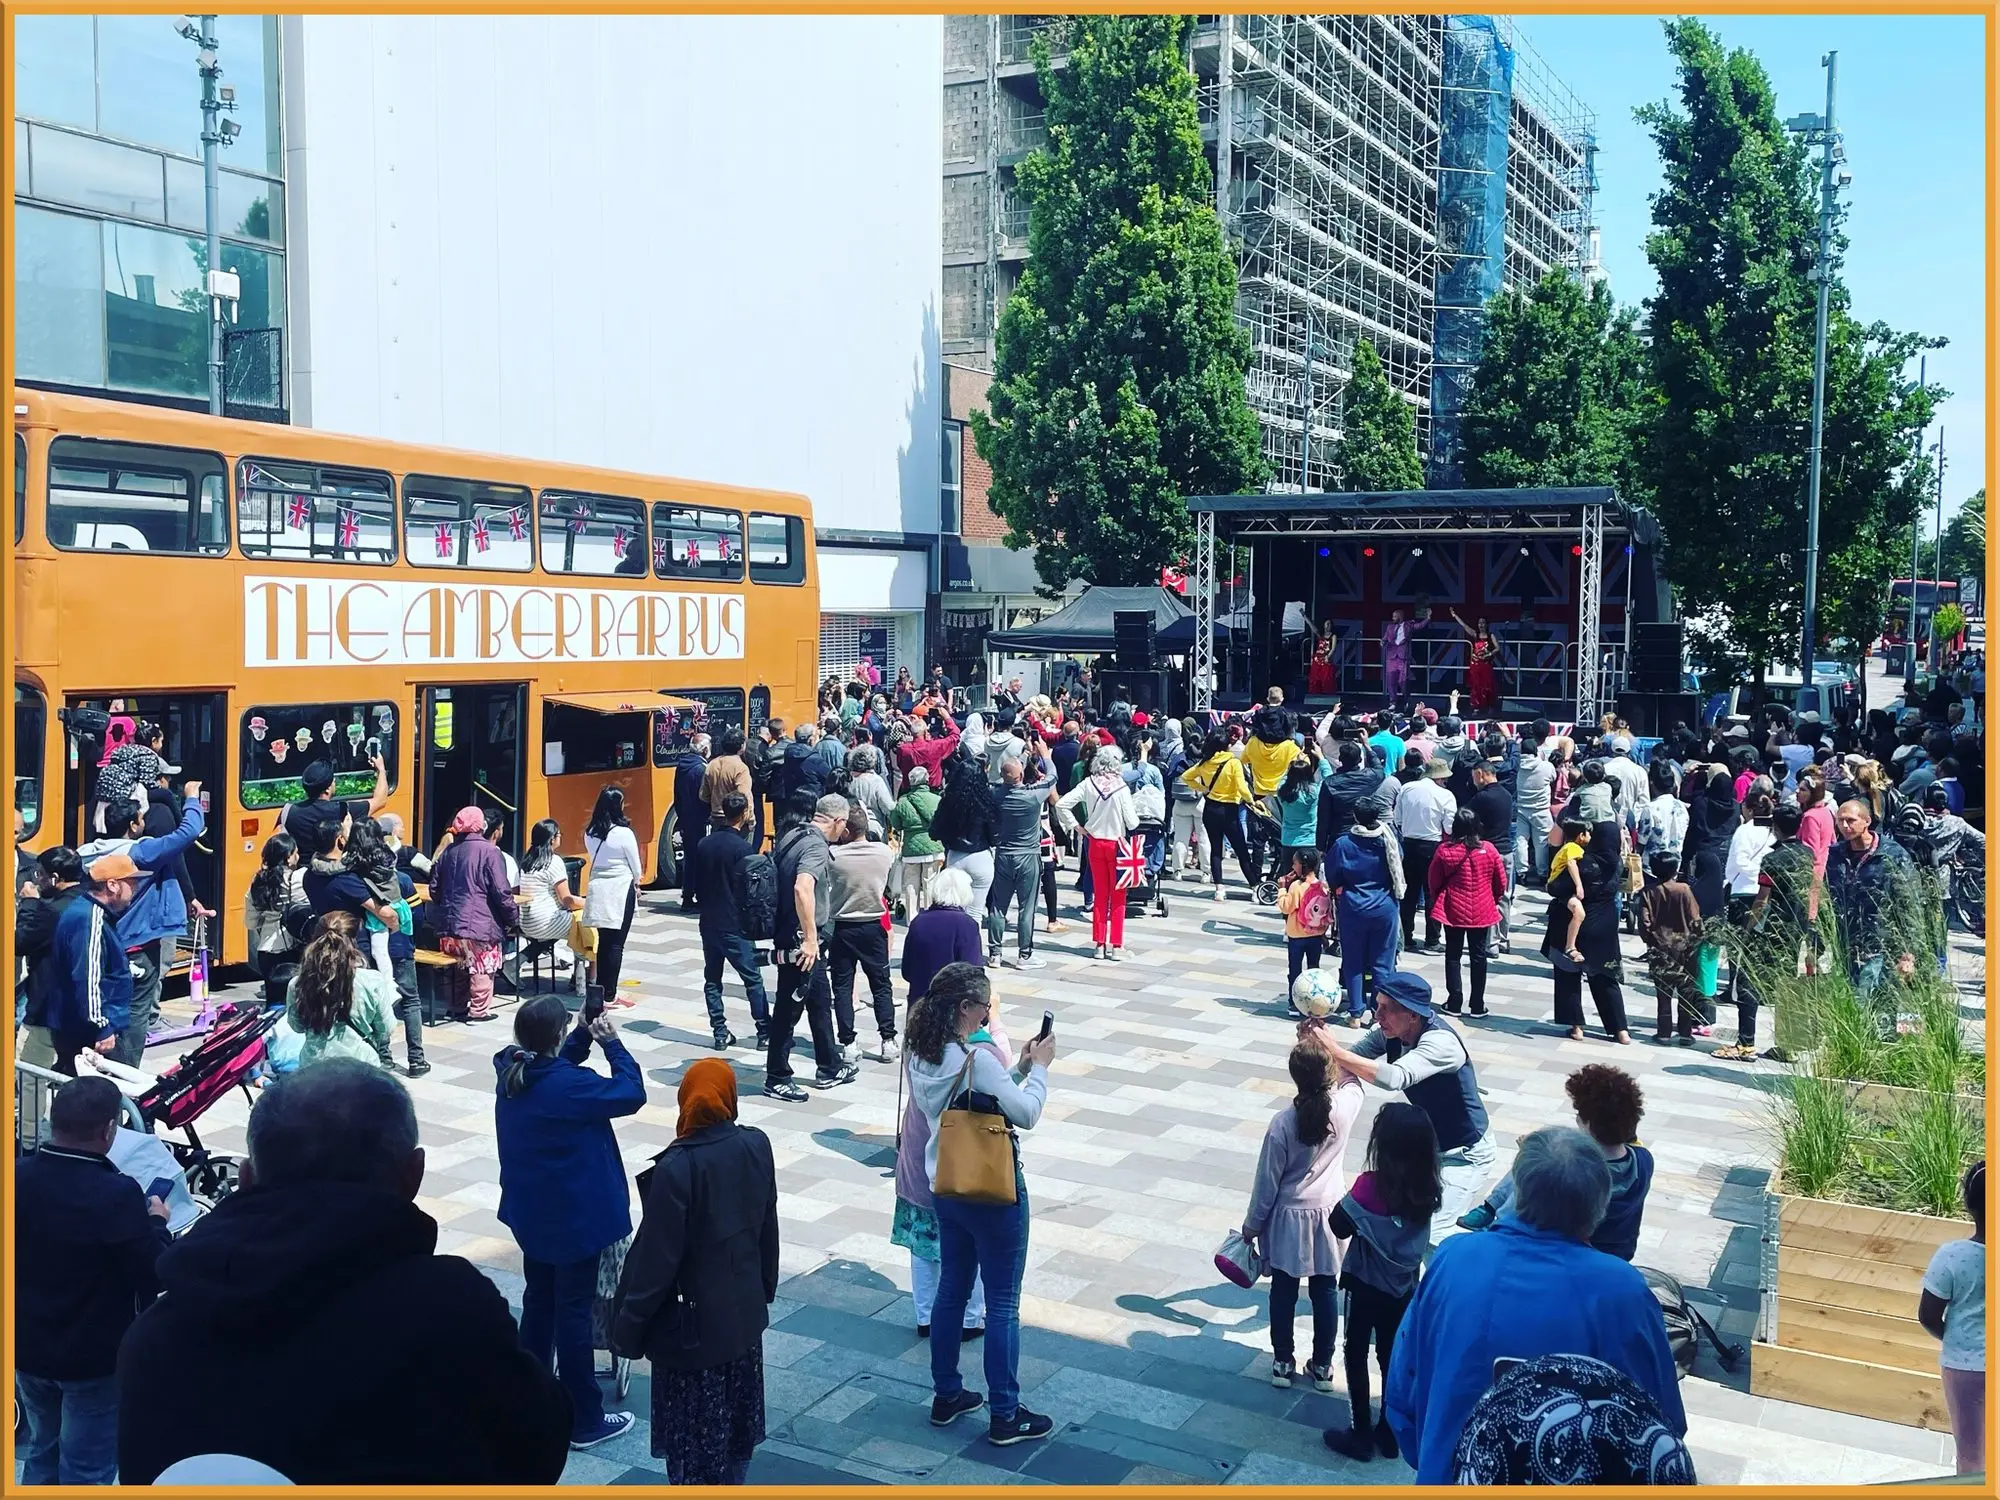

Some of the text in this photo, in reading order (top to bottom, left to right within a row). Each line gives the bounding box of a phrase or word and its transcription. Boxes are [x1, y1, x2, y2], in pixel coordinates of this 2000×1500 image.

[250, 582, 742, 662] THE AMBER BAR BUS
